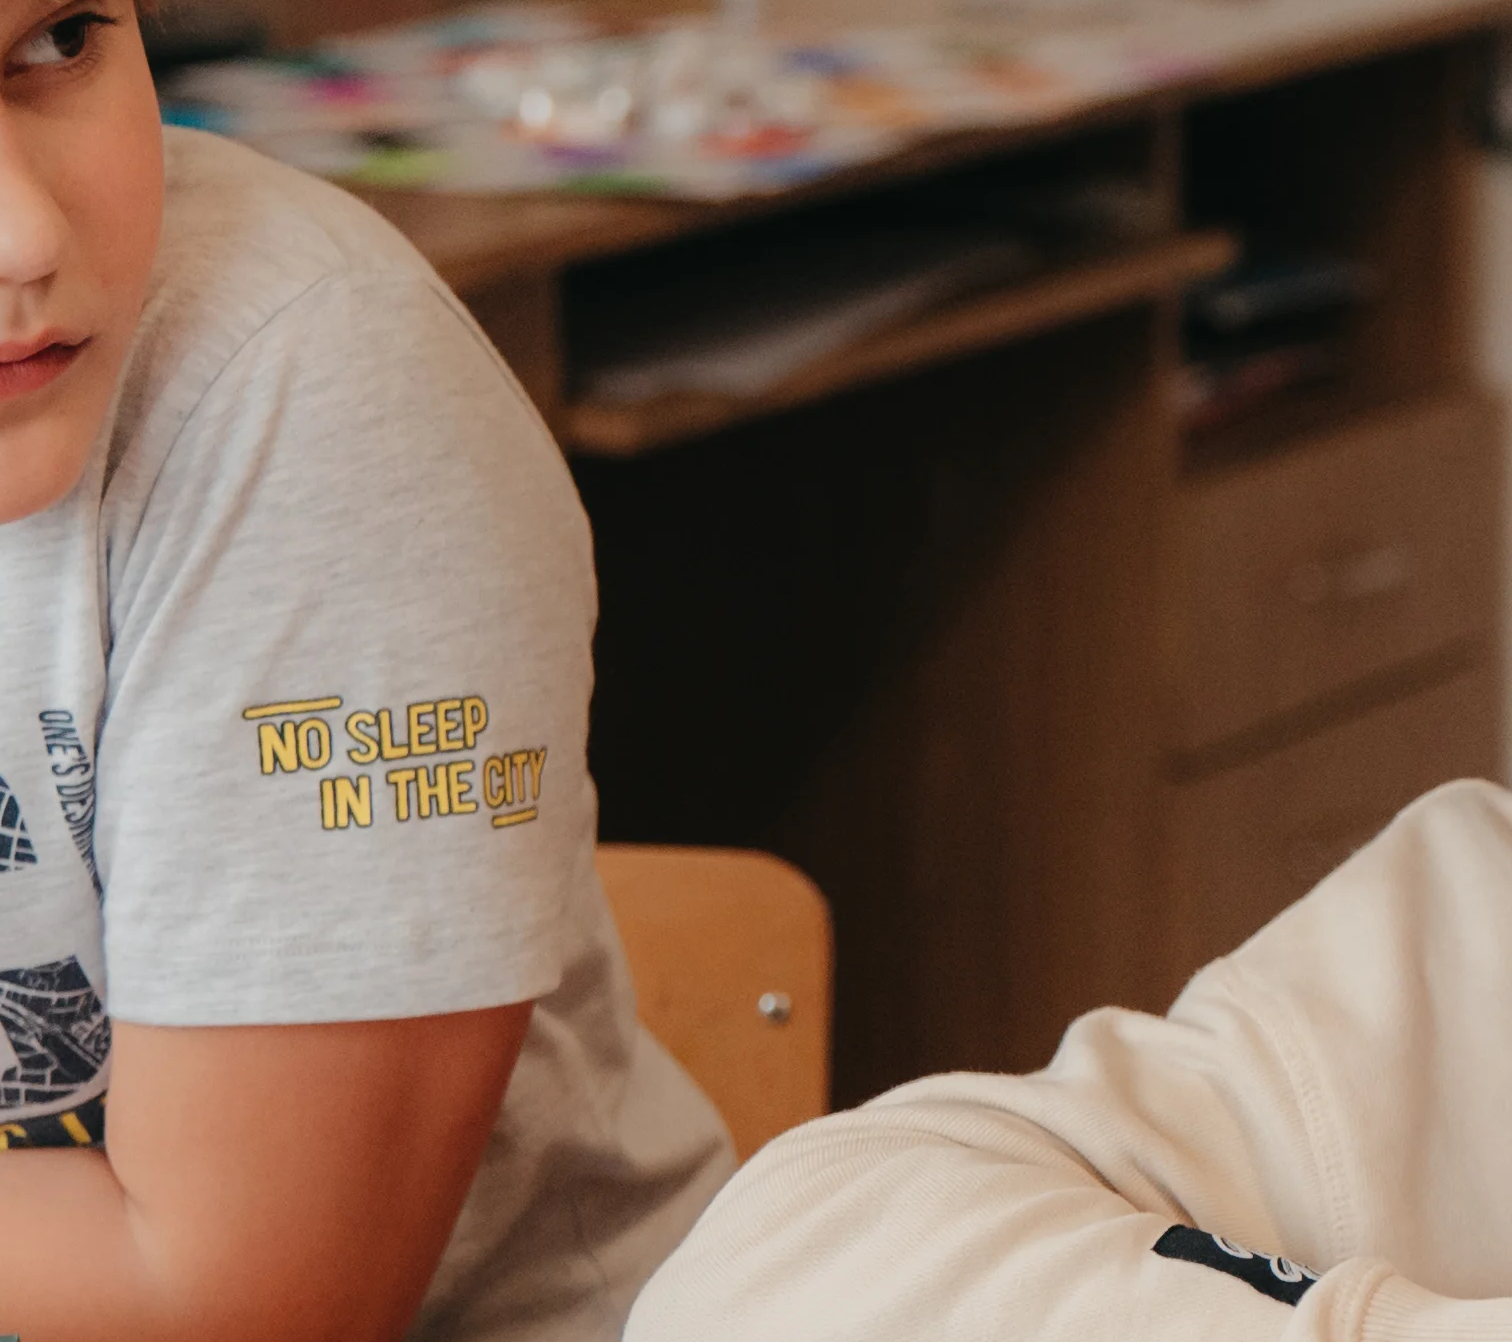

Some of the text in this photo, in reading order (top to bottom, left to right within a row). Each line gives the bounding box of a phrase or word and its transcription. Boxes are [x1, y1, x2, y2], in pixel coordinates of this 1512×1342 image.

[257, 695, 489, 776] NO SLEEP
[319, 746, 549, 831] IN THE CITY
